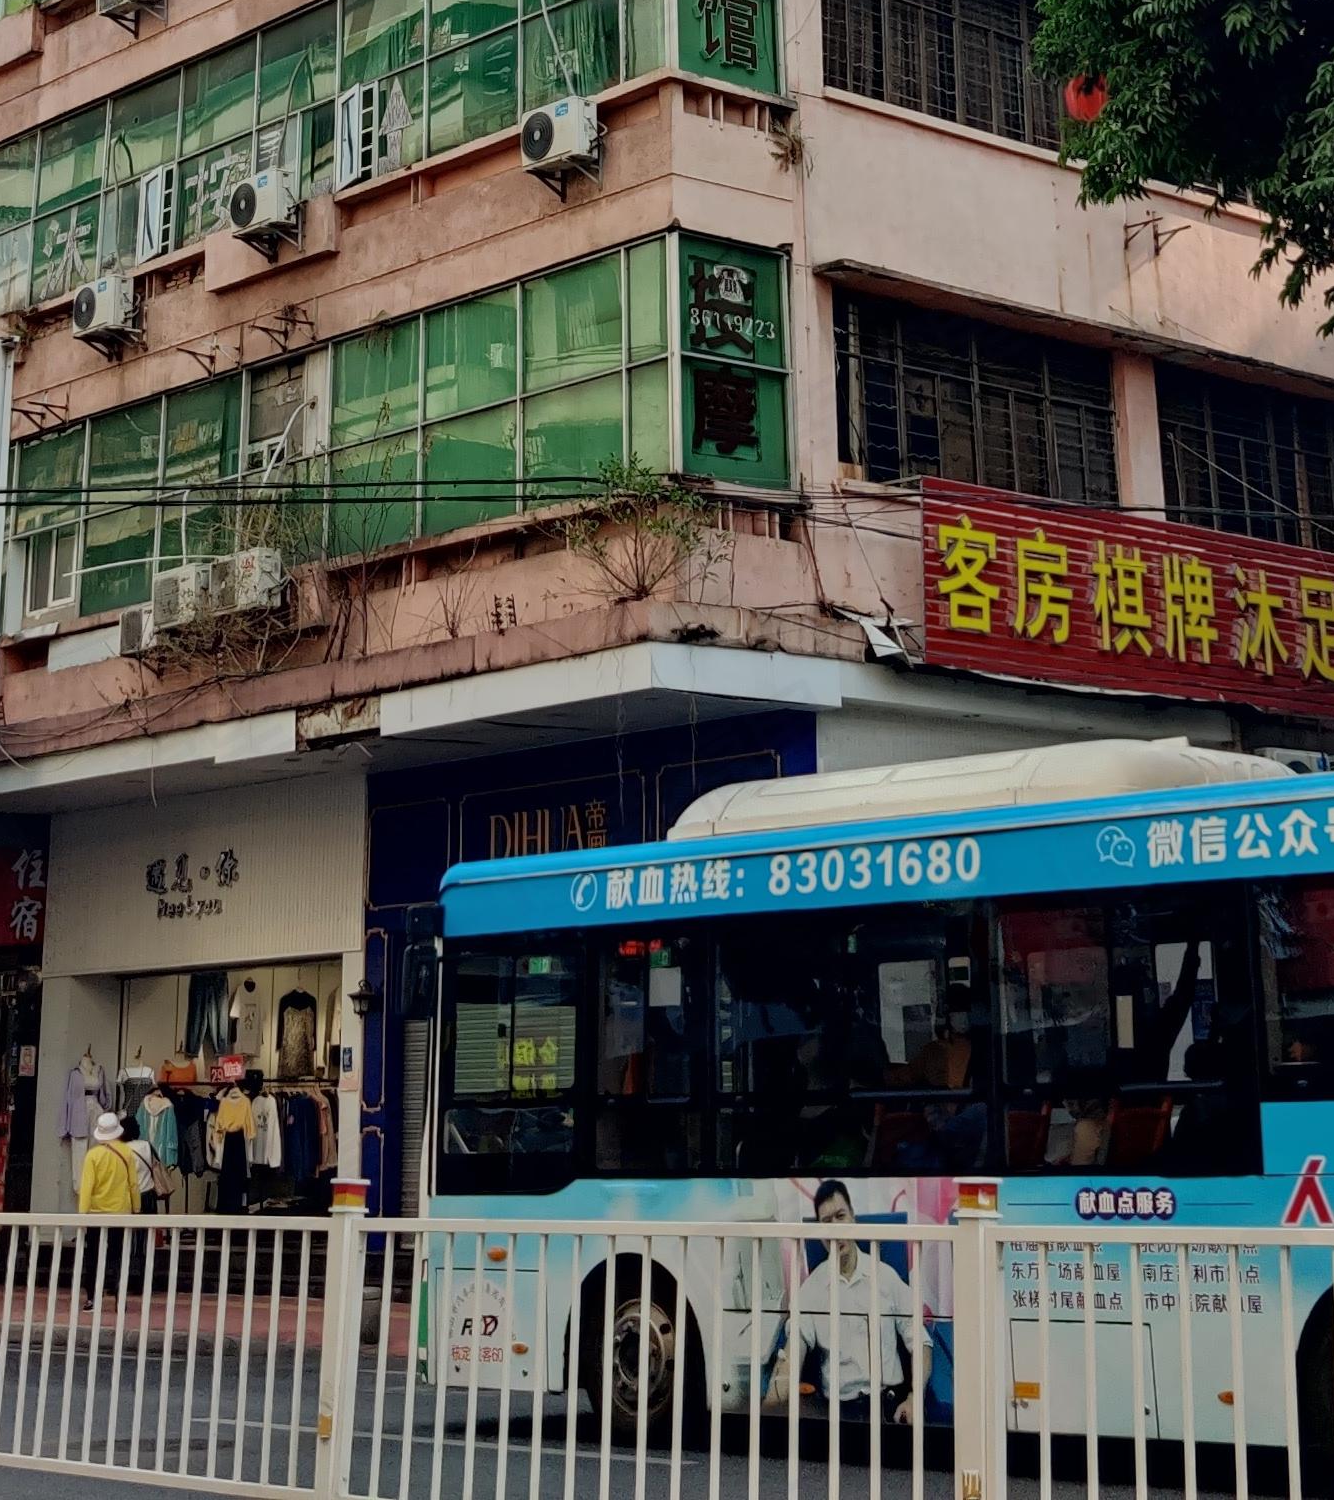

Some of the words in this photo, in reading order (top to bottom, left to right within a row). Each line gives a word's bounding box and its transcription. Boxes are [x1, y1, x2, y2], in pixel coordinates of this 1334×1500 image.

[9, 848, 47, 942] 住宿
[767, 835, 983, 897] 83031680
[1077, 1191, 1174, 1215] 献血点服务
